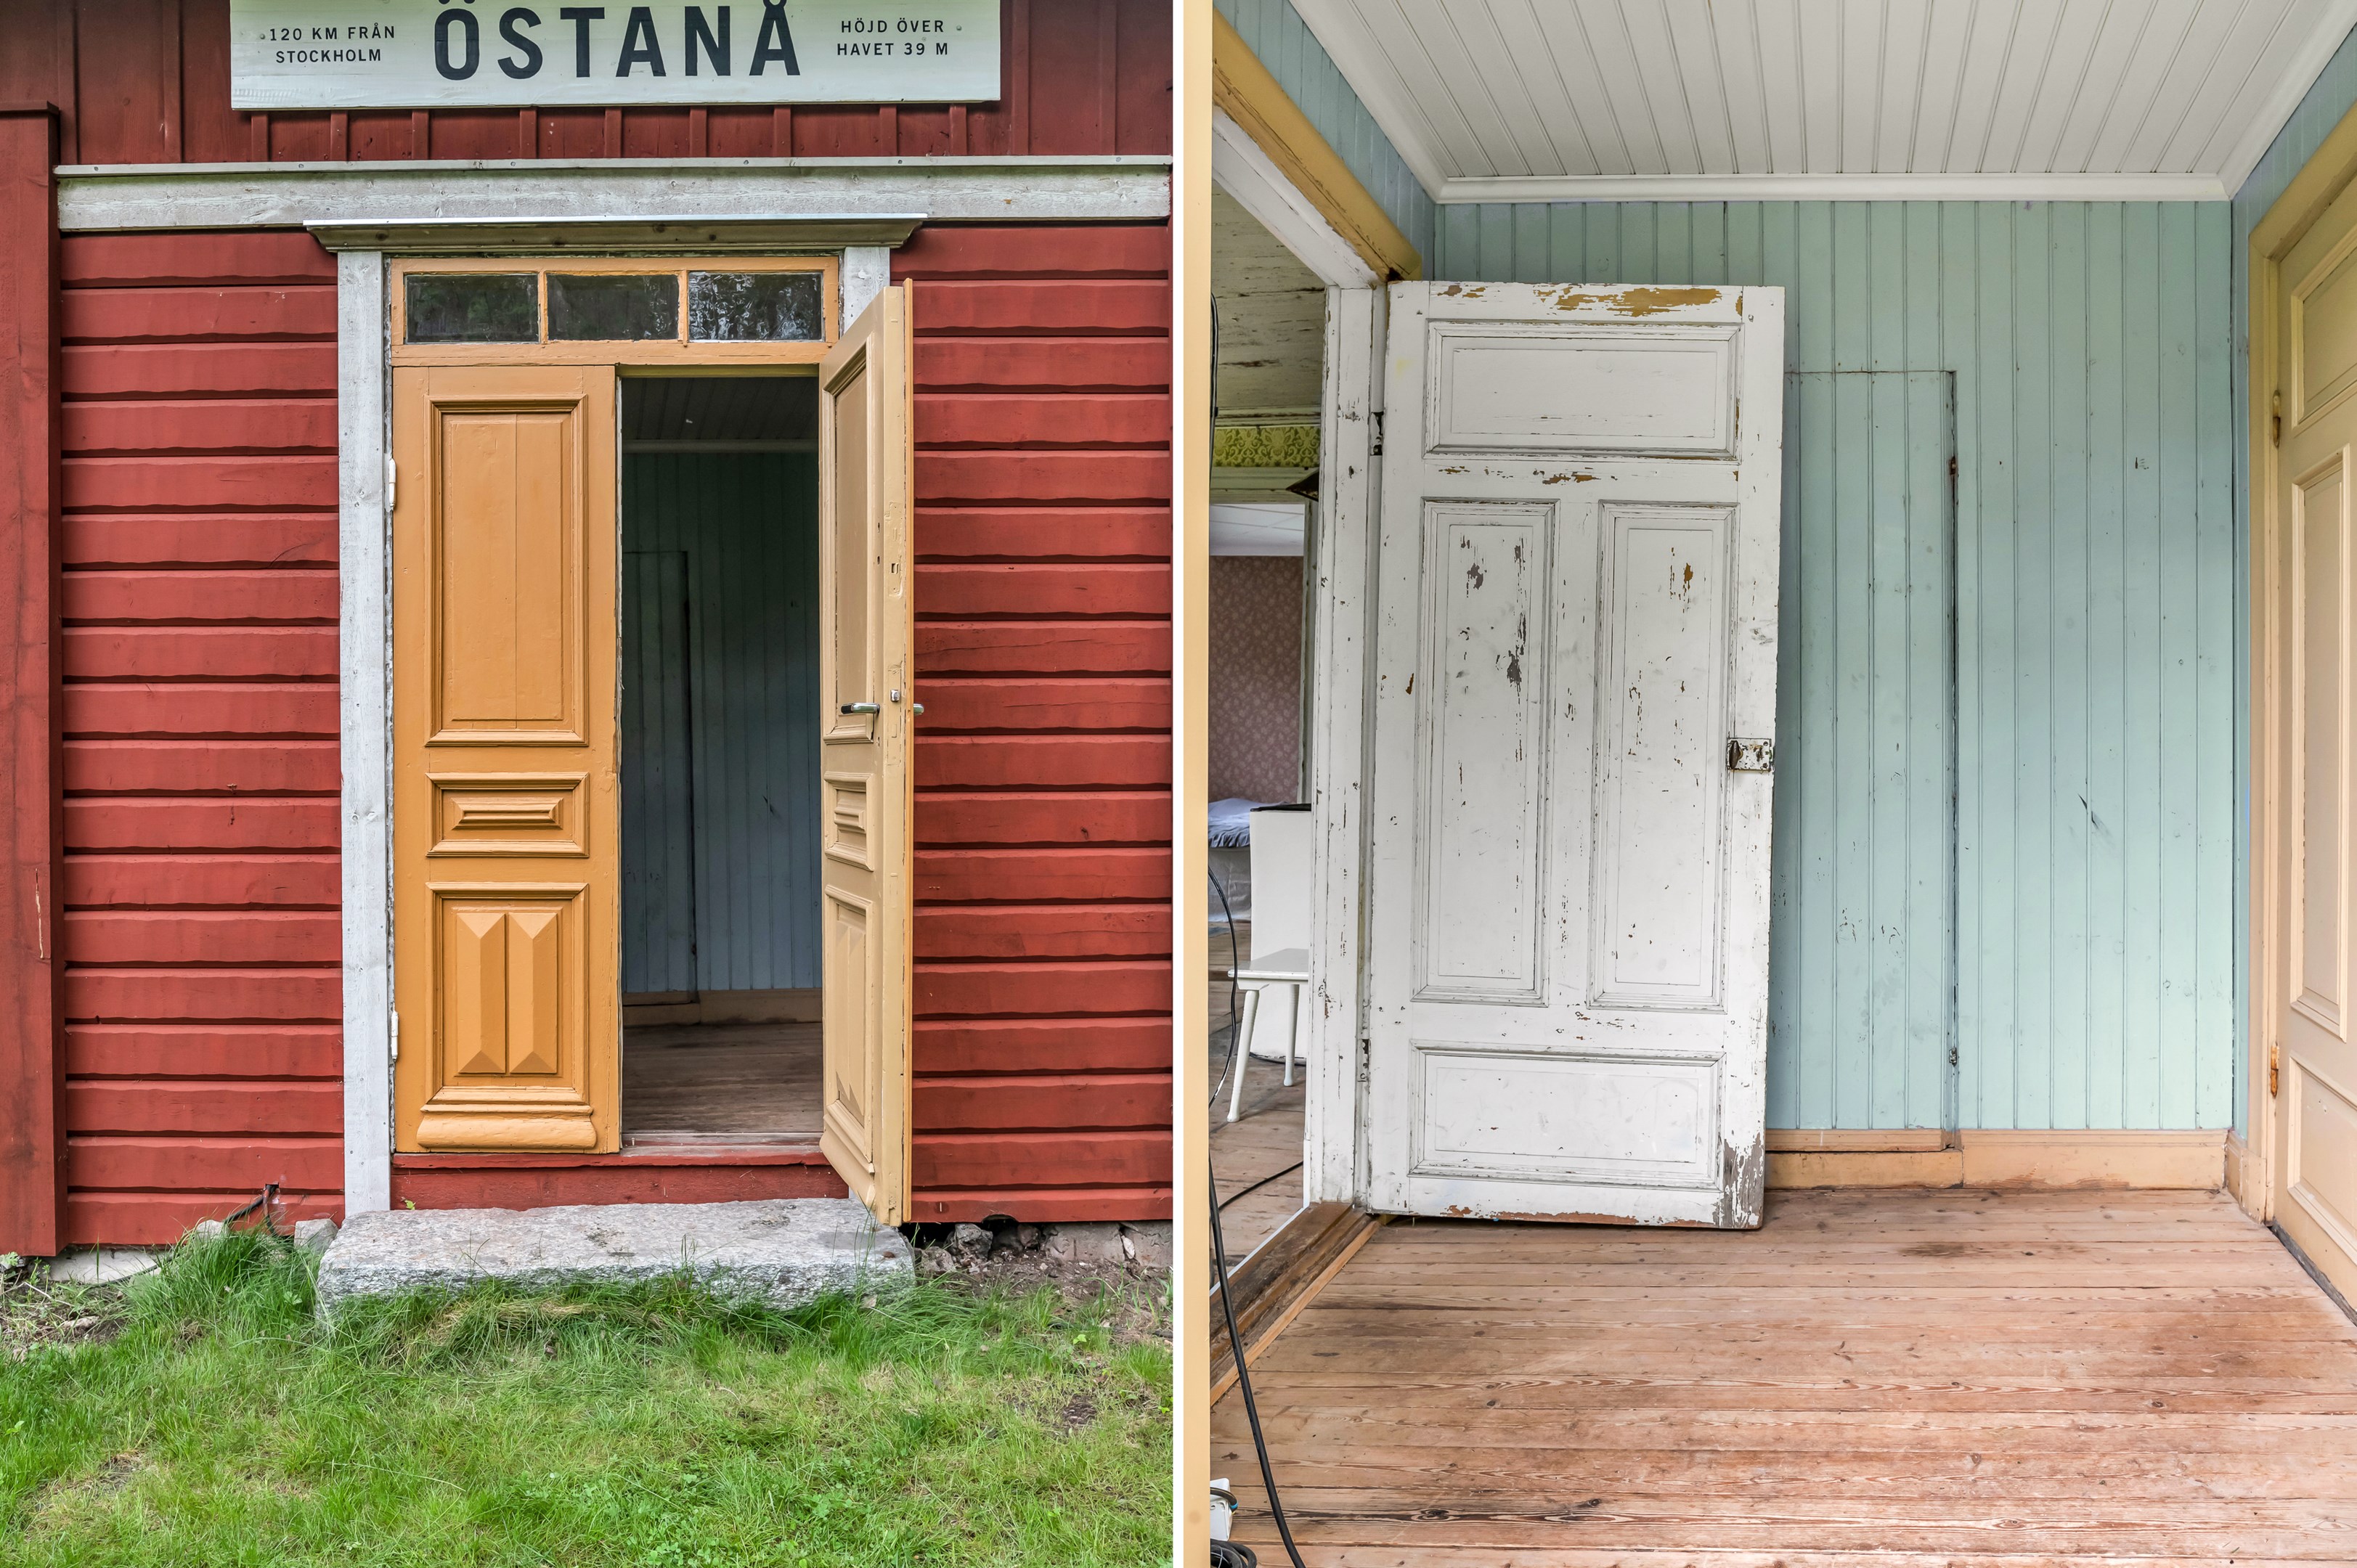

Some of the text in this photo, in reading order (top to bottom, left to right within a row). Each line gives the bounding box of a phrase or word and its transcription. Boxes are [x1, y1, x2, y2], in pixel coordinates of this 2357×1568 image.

[269, 22, 395, 41] 120 KM FRÅN
[841, 17, 944, 33] HÖJD ÖVER
[433, 0, 801, 81] ÖSTANÅ
[275, 49, 382, 64] STOCKHOLM
[837, 42, 948, 56] HAVET 39 M
